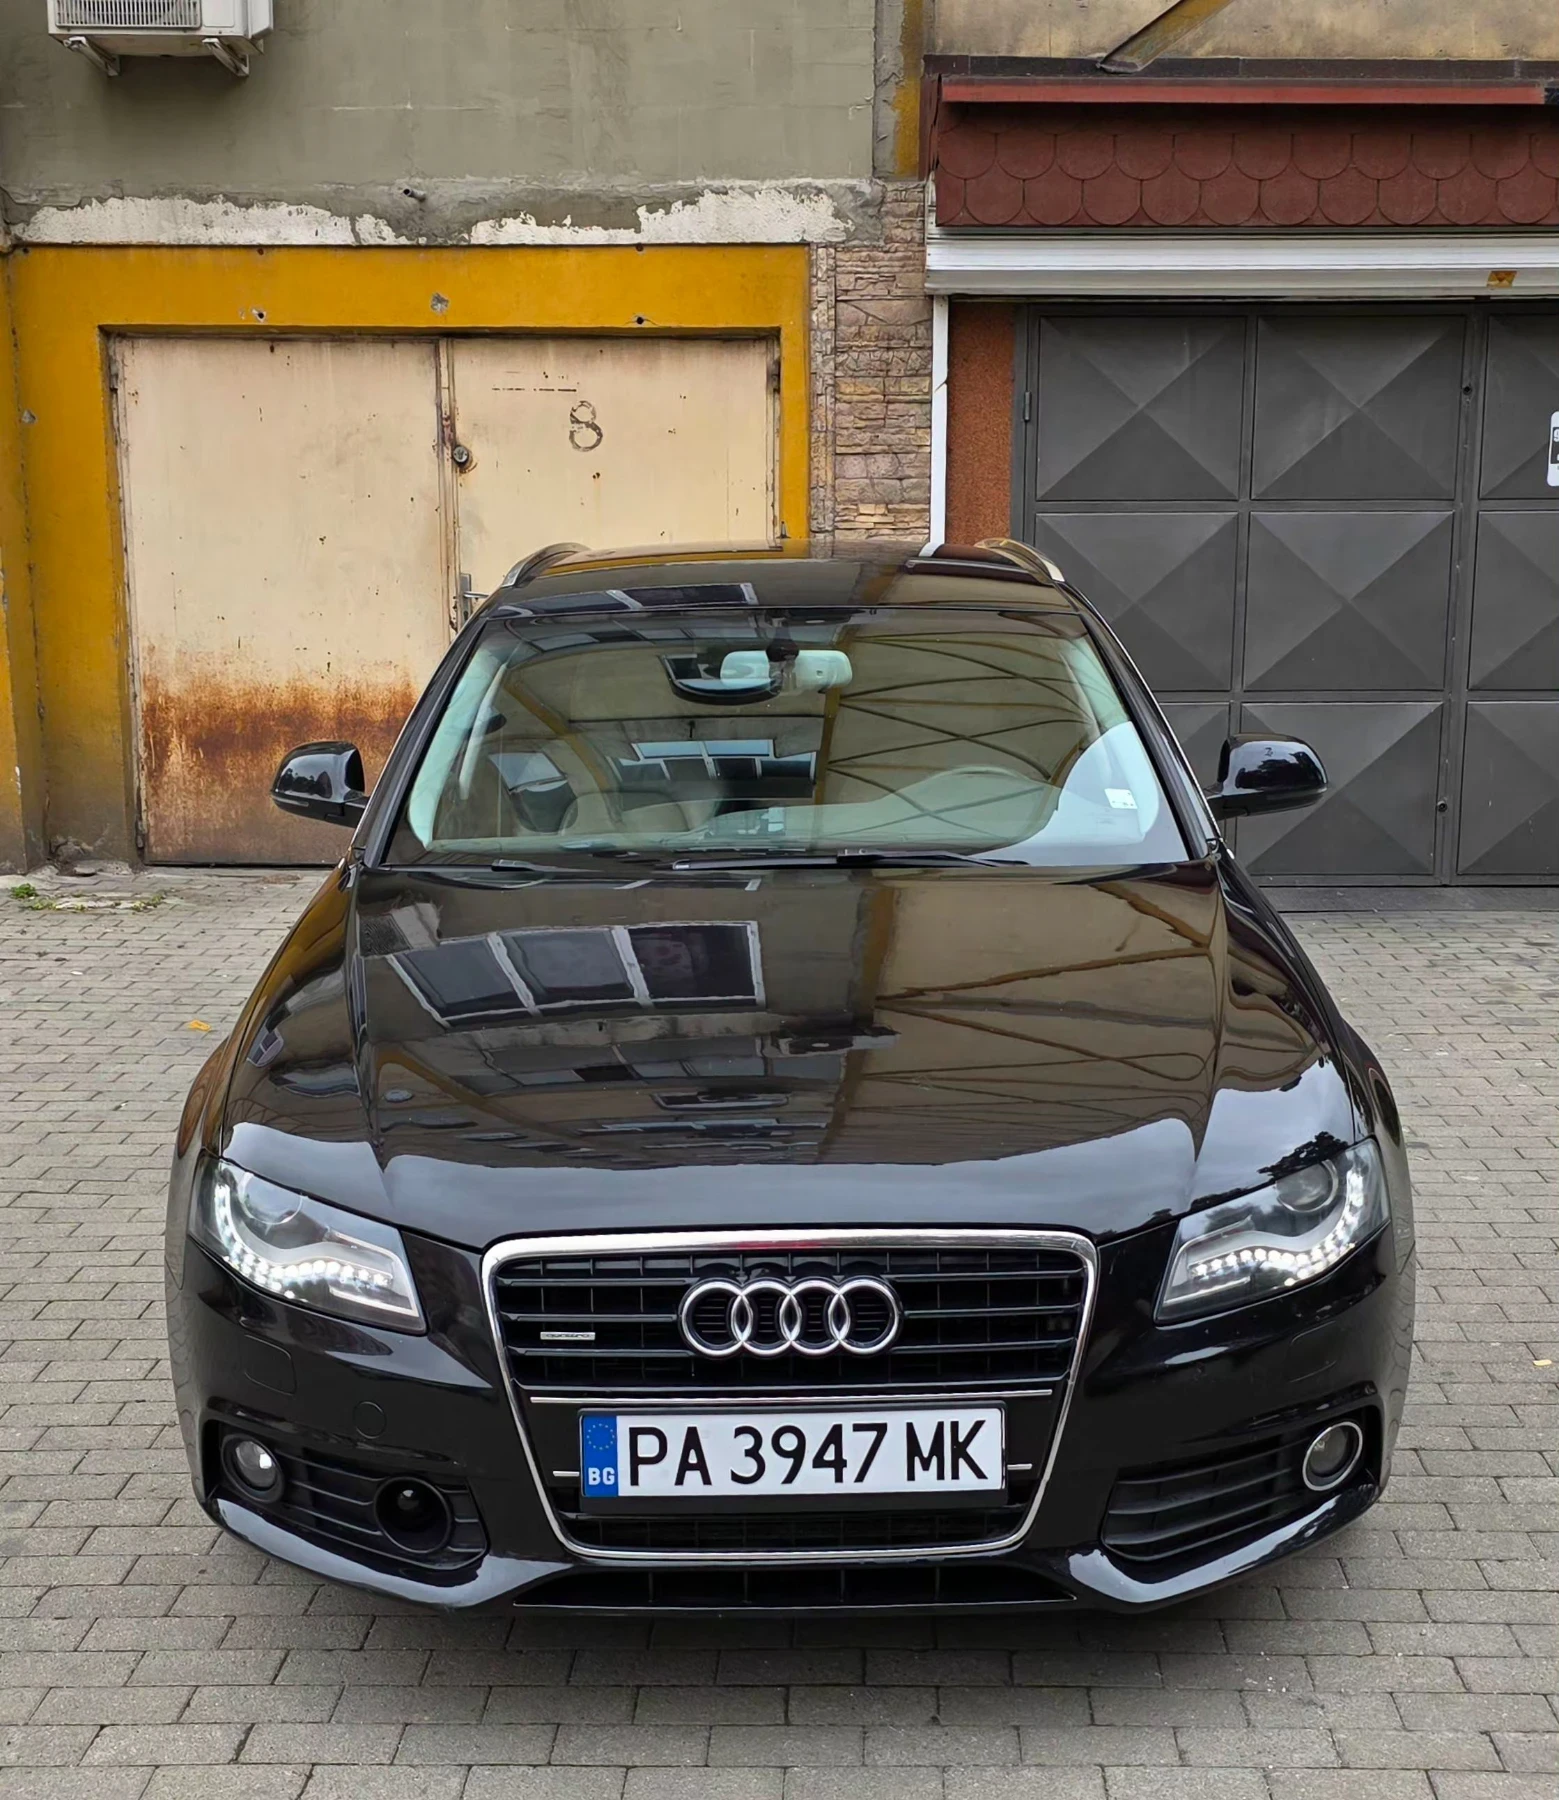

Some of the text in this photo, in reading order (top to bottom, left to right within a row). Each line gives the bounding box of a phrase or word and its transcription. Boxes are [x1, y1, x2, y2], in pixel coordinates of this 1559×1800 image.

[569, 400, 603, 452] 8
[588, 1466, 616, 1486] BG
[627, 1419, 988, 1487] PA 3947 MK
